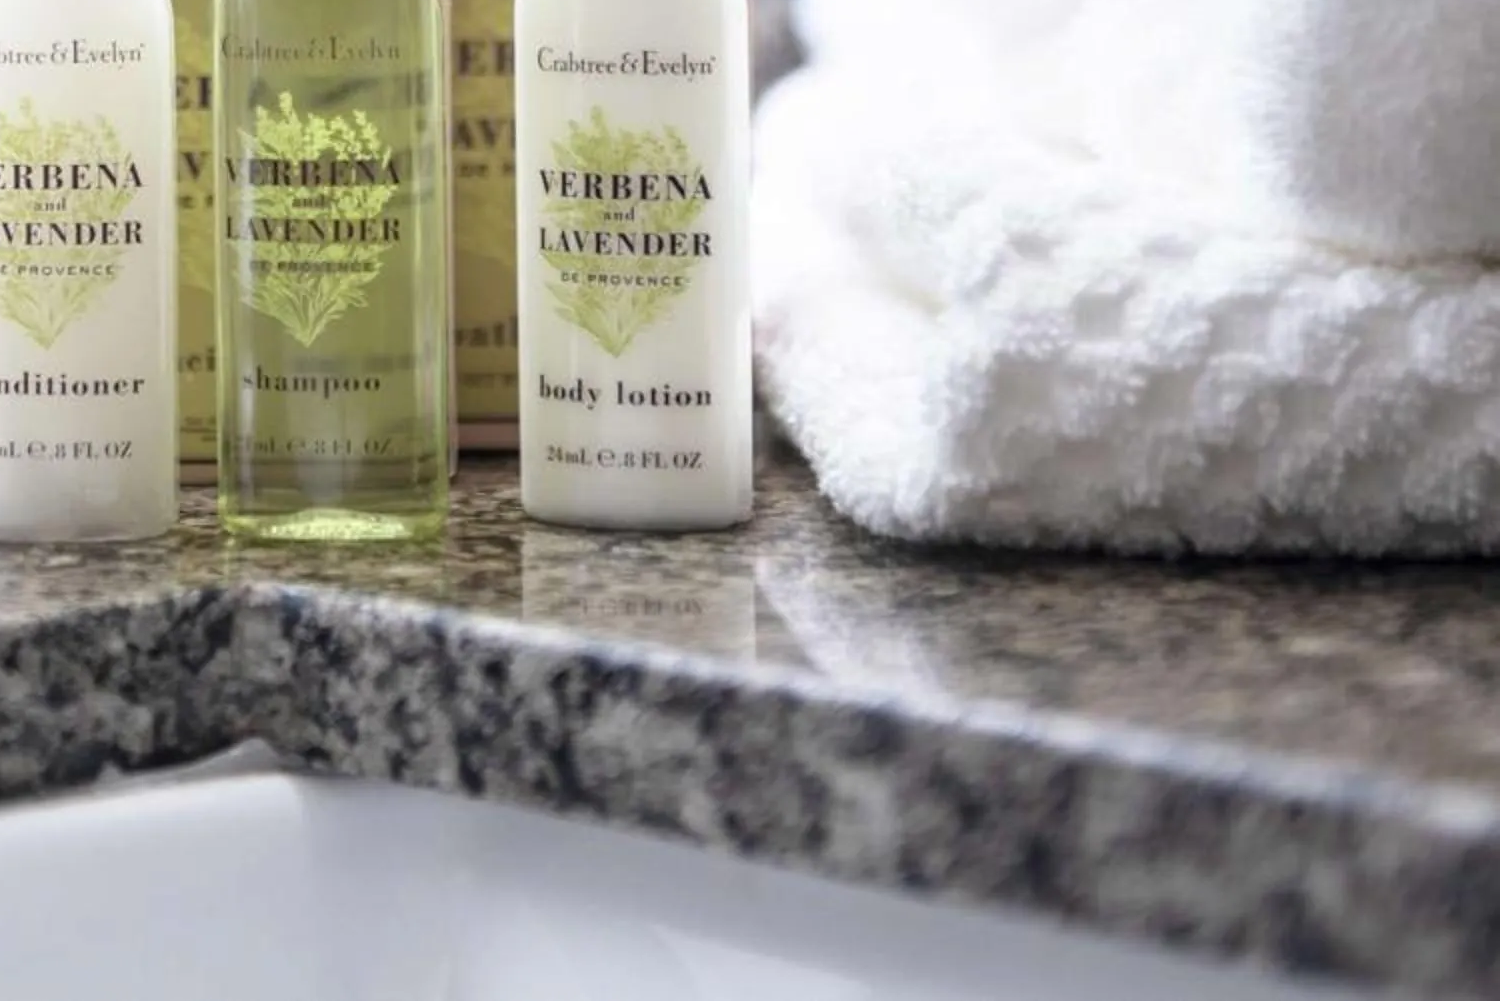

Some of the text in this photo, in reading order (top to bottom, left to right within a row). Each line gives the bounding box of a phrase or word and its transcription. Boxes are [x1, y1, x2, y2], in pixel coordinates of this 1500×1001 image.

[537, 47, 616, 74] Crabtree
[225, 158, 400, 185] VERBENA
[540, 170, 713, 201] VERBENA
[33, 198, 67, 212] and
[603, 207, 635, 221] and
[225, 216, 400, 242] LAVENDER
[540, 227, 712, 257] LAVENDER
[17, 264, 115, 276] PROVENCE
[561, 272, 684, 288] DE PROVENCE
[243, 366, 381, 399] shampoo
[539, 375, 602, 409] body
[616, 381, 712, 407] lotion
[104, 440, 132, 460] OZ
[672, 452, 703, 469] OZ
